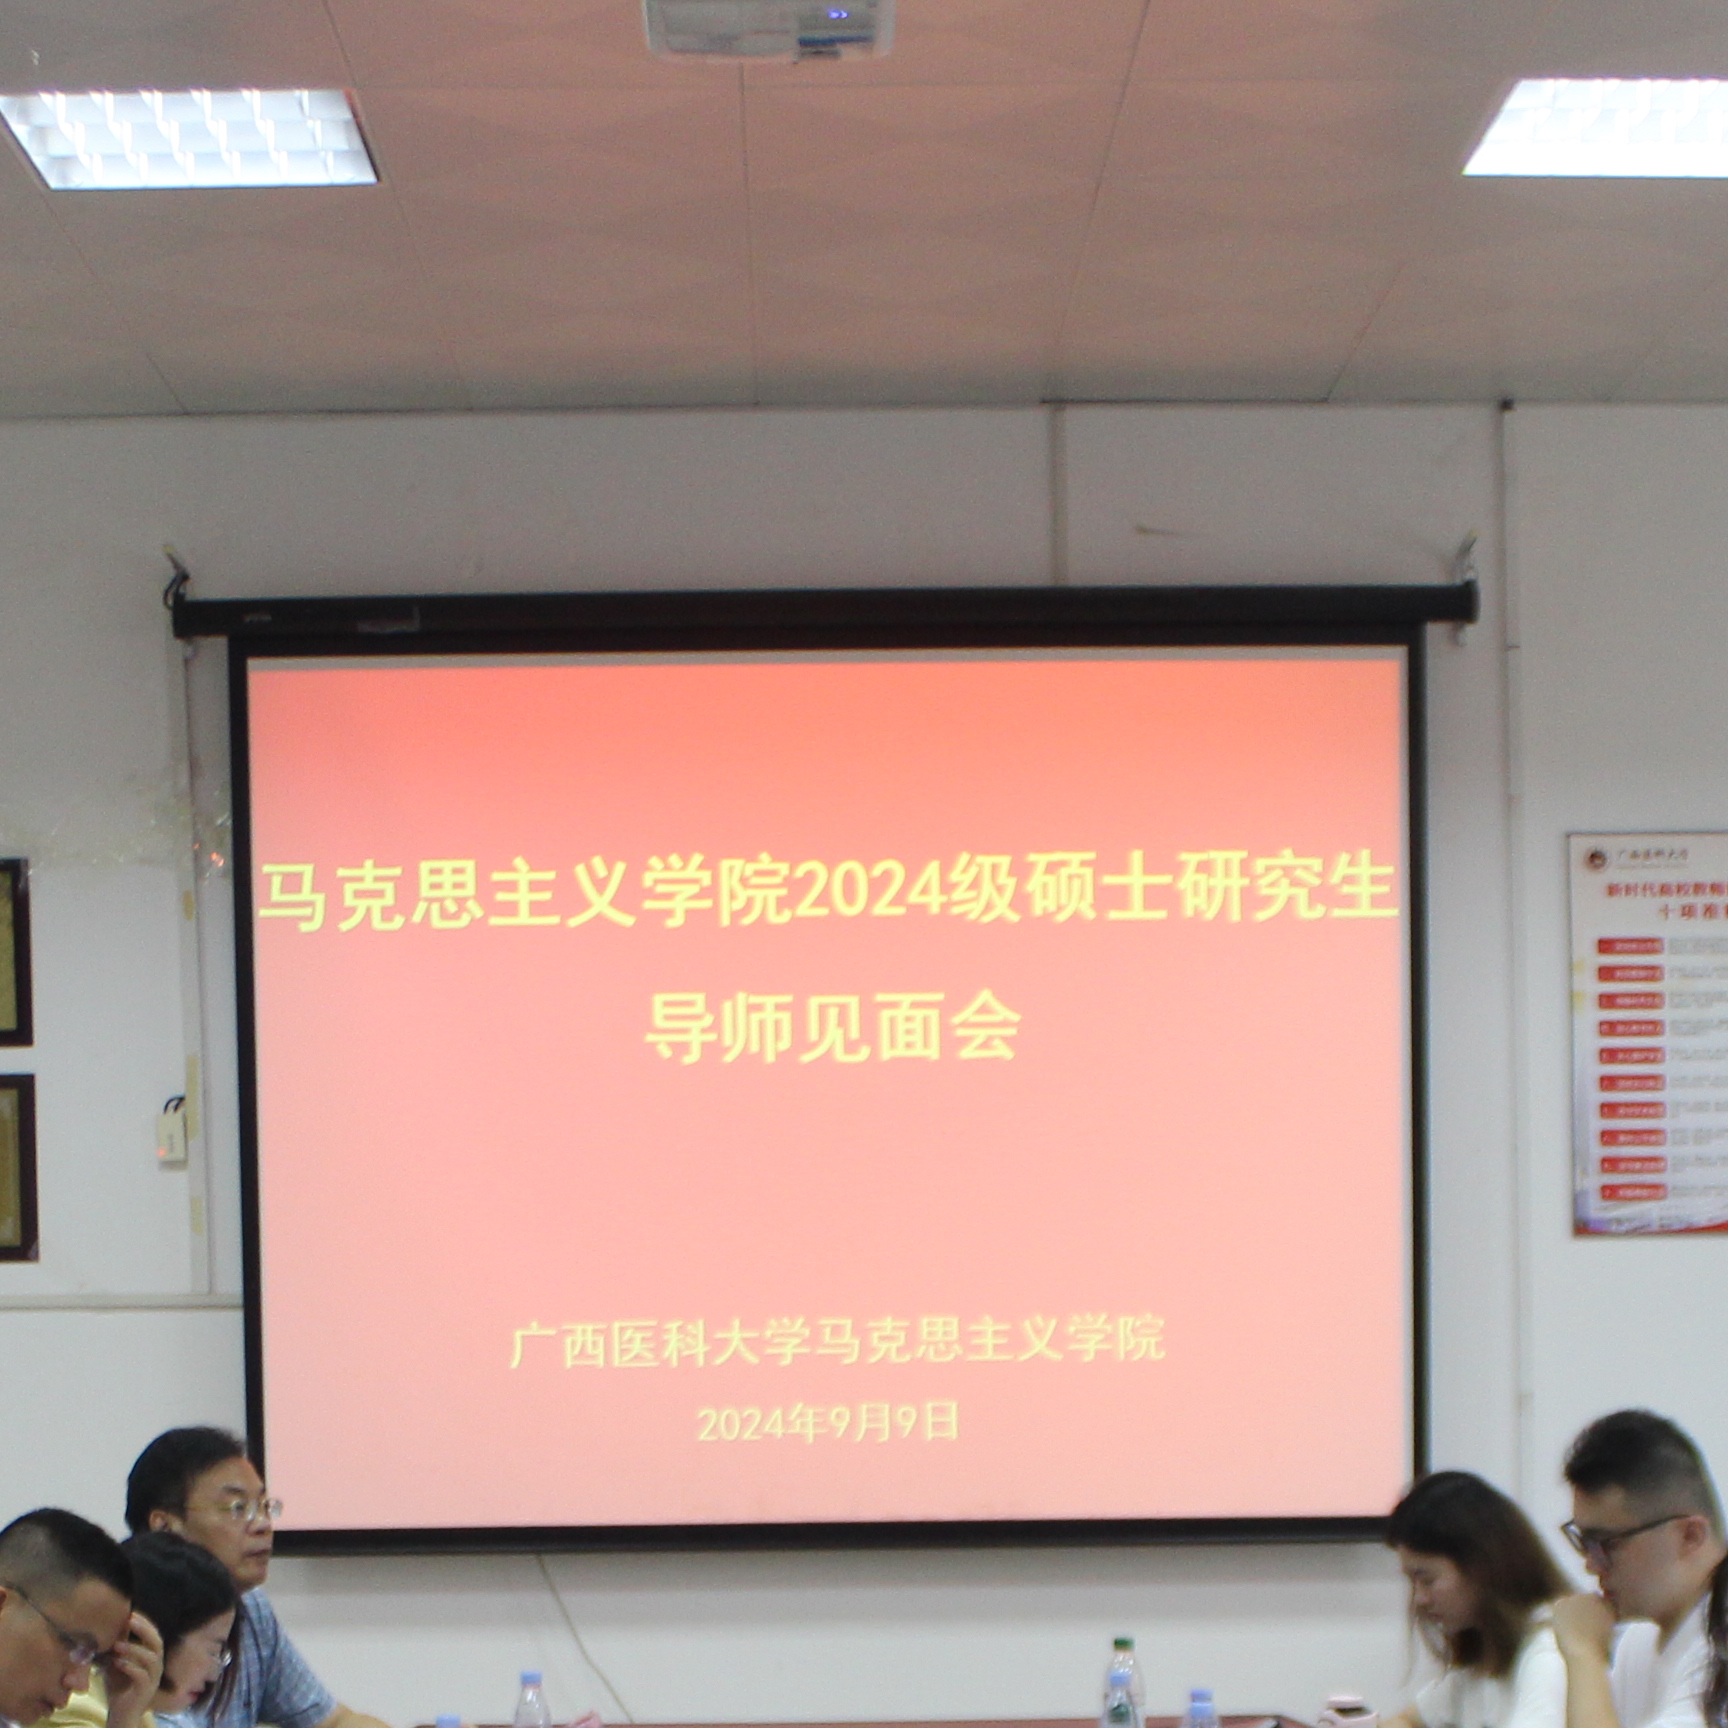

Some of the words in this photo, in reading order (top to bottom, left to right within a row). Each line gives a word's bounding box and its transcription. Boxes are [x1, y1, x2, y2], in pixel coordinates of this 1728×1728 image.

[257, 848, 1401, 934] 马克思主义学院2024级硕士研究生
[645, 990, 1022, 1065] 导师见面会
[508, 1314, 1168, 1372] 广西医科大学马克思主义学院
[696, 1402, 961, 1445] 2024年9月9日
